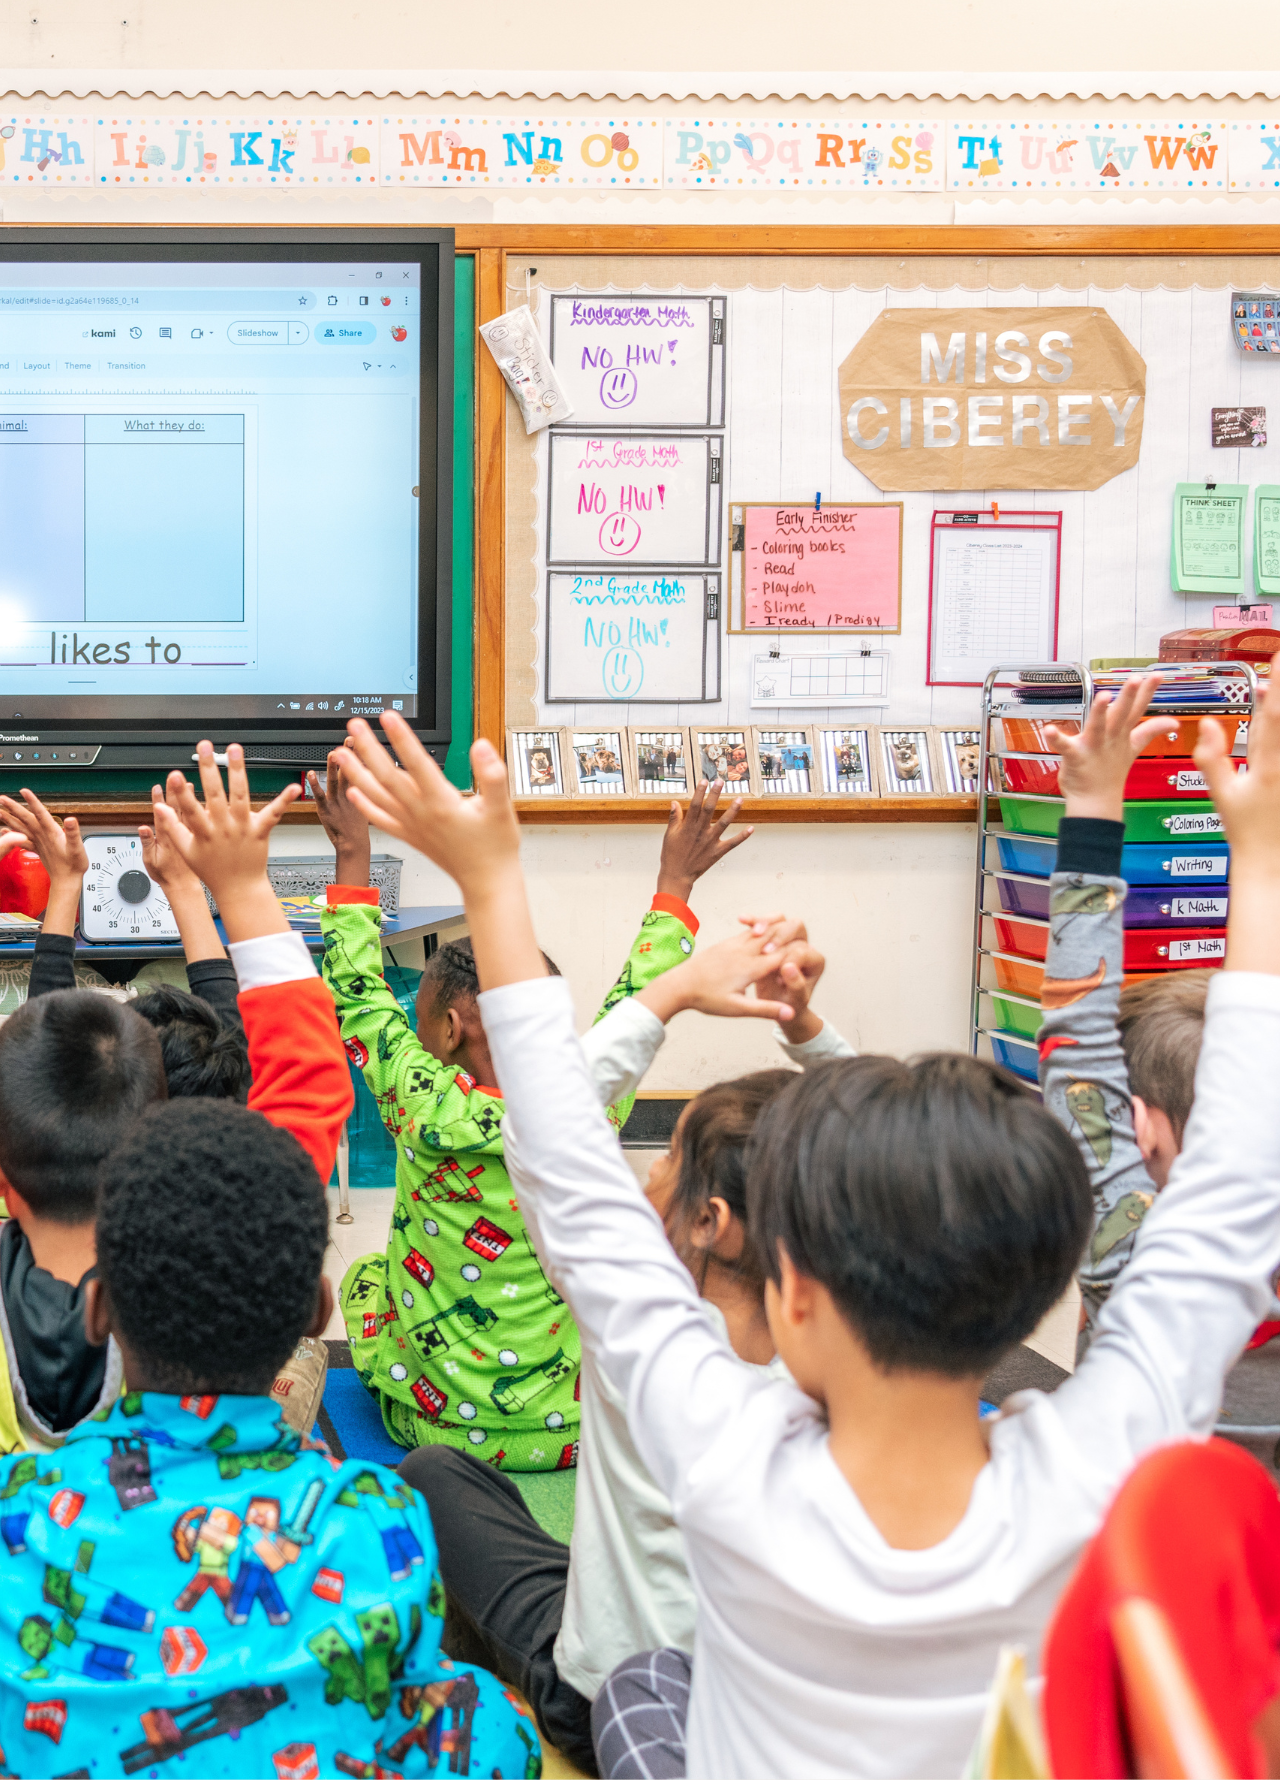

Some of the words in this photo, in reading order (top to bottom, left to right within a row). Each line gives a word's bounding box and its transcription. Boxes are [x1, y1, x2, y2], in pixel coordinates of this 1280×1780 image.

[572, 300, 651, 319] Kindergarten
[91, 328, 117, 339] kami
[237, 328, 279, 338] Slideshow
[339, 328, 363, 338] Share
[513, 337, 545, 386] Sticker
[581, 346, 614, 370] NO
[626, 339, 679, 367] HW!
[920, 330, 1074, 384] MISS
[23, 361, 51, 372] Layout
[64, 361, 92, 371] Theme
[107, 361, 146, 371] Transition
[124, 419, 156, 431] What
[158, 419, 184, 434] they
[186, 419, 206, 431] do:
[846, 394, 1142, 451] CIBEREY
[586, 439, 605, 460] 1st
[613, 440, 647, 460] Grade
[652, 444, 680, 459] Math
[577, 482, 607, 514] NO
[619, 484, 666, 512] HW!
[1185, 499, 1210, 507] THINK
[776, 510, 805, 529] Early
[812, 511, 858, 524] Finisher
[762, 540, 805, 561] Coloring
[810, 540, 846, 554] books
[764, 562, 796, 576] Read
[570, 576, 604, 595] 2nd
[608, 577, 649, 596] Grade
[652, 577, 686, 598] Math
[763, 581, 817, 597] Playdoh
[763, 600, 807, 614] Slime
[764, 615, 816, 629] Iready
[584, 616, 622, 648] NO
[628, 616, 671, 648] HW!
[51, 631, 131, 665] likes
[144, 635, 182, 665] to
[350, 706, 385, 715] 12/15/2023
[1173, 816, 1206, 832] Coloring
[106, 846, 117, 854] 55
[91, 862, 101, 870] 50
[1175, 857, 1214, 875] Writing
[86, 884, 96, 892] 45
[92, 904, 102, 913] 40
[1188, 899, 1220, 915] Math
[108, 920, 118, 928] 35
[130, 926, 140, 934] 30
[152, 919, 162, 928] 25
[1178, 941, 1191, 957] 1st
[1196, 941, 1223, 954] Math
